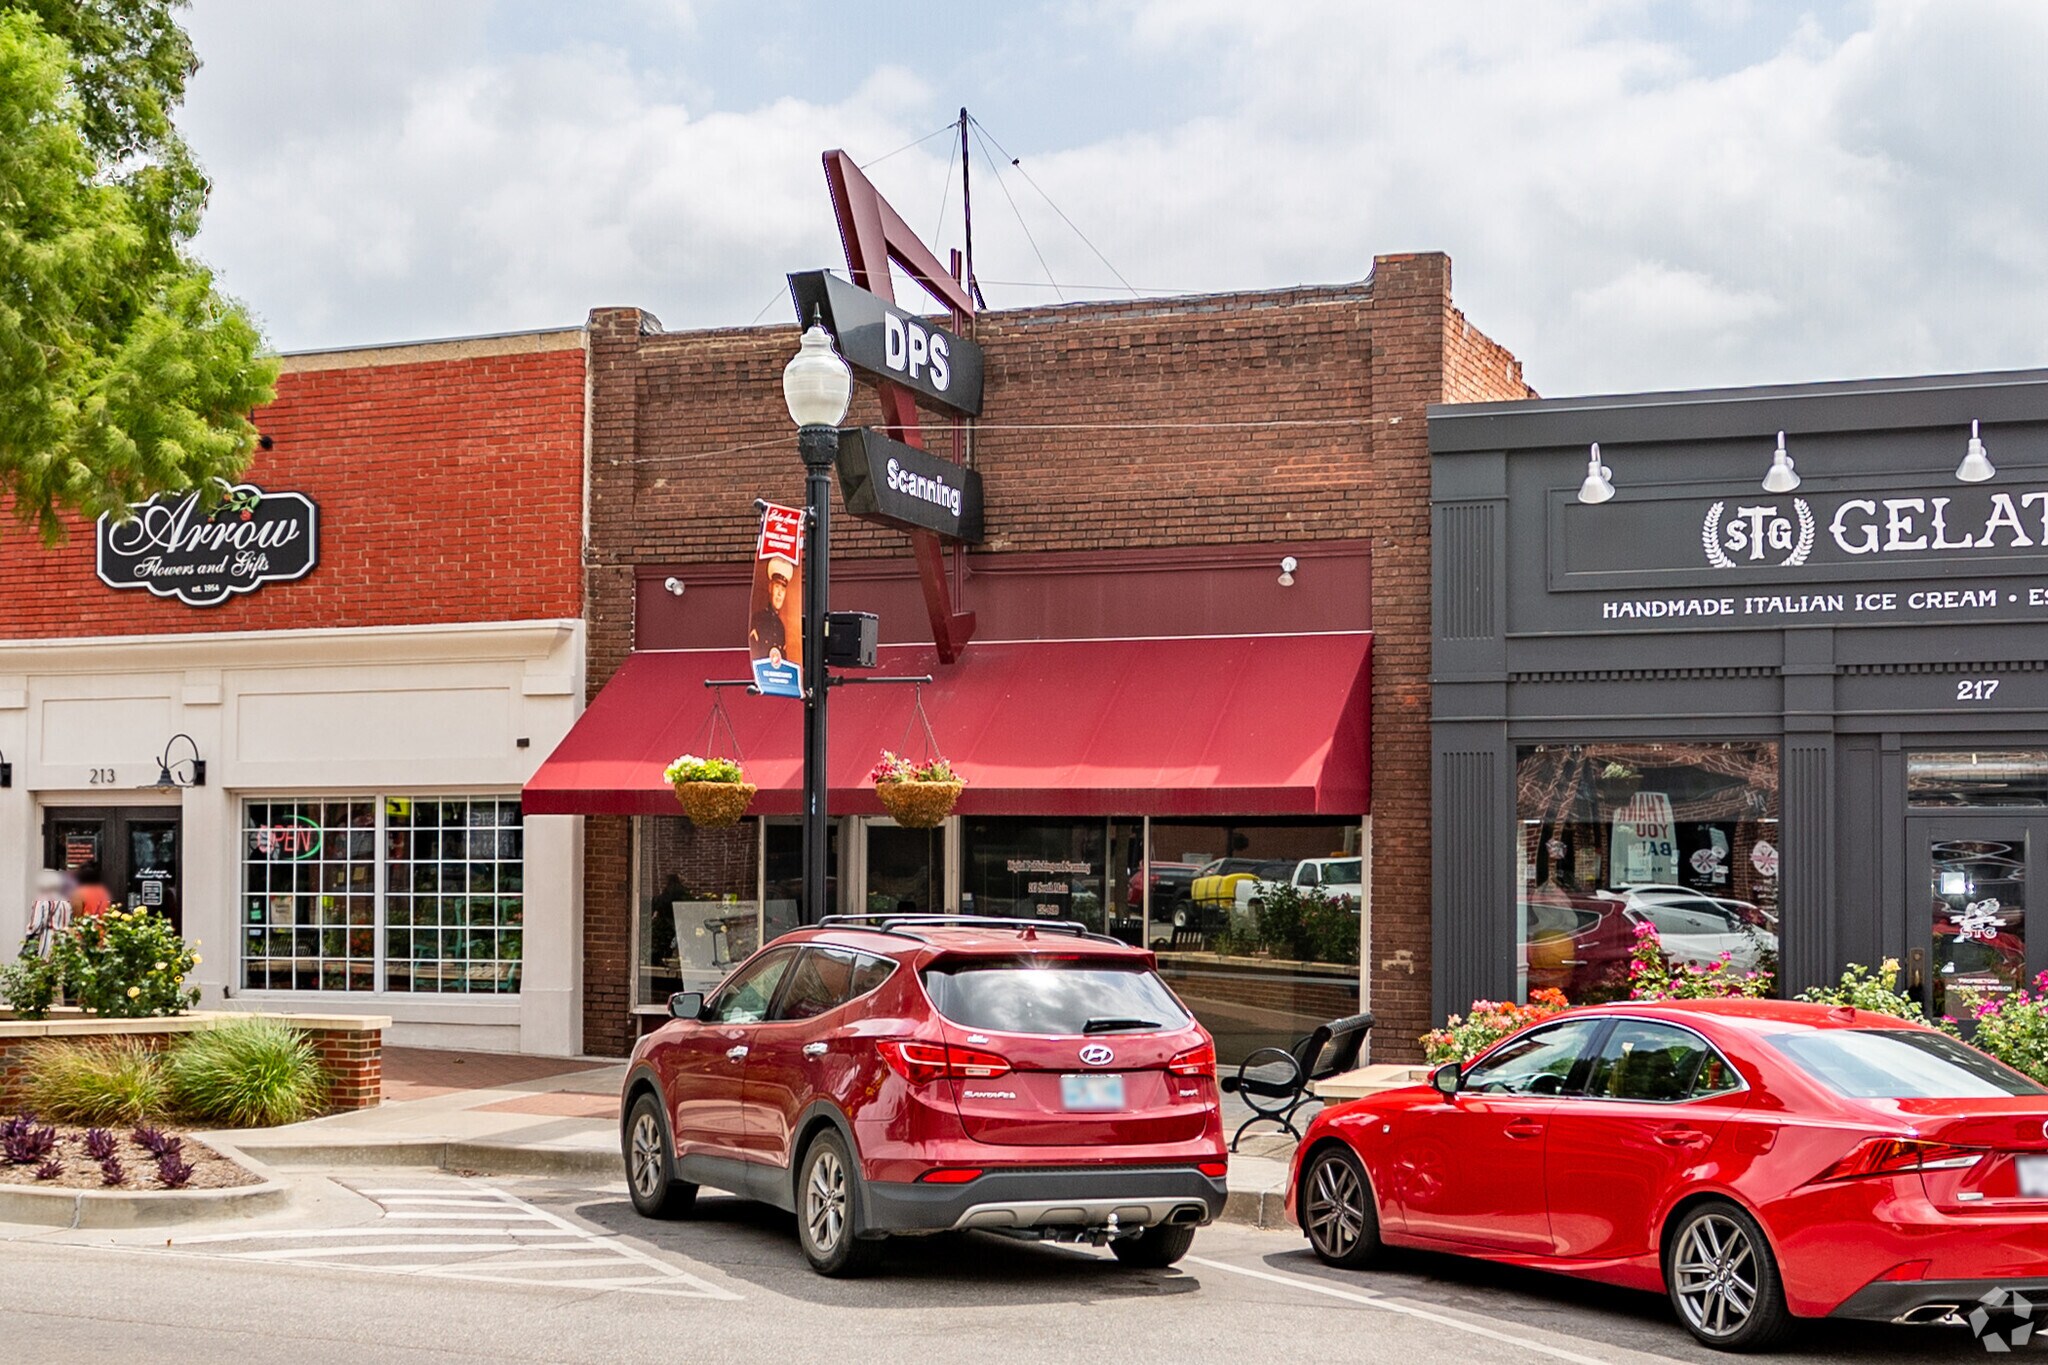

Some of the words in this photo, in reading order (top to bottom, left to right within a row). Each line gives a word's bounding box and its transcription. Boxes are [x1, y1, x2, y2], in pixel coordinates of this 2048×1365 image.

[884, 310, 950, 392] DPS
[886, 457, 962, 518] Scanning
[109, 489, 300, 556] Arrow
[1724, 505, 1793, 561] STG
[133, 555, 194, 578] Flowers
[196, 554, 230, 575] and
[230, 550, 269, 579] Gifts
[191, 584, 202, 593] est.
[203, 583, 220, 593] 1954
[1602, 598, 1735, 619] HANDMADE
[1744, 595, 1844, 615] ITALIAN
[1854, 593, 1898, 612] ICE
[1908, 589, 1998, 610] CREAM
[2028, 588, 2048, 606] E
[1957, 680, 1999, 700] 217
[89, 768, 116, 784] 213
[256, 823, 312, 853] OPEN
